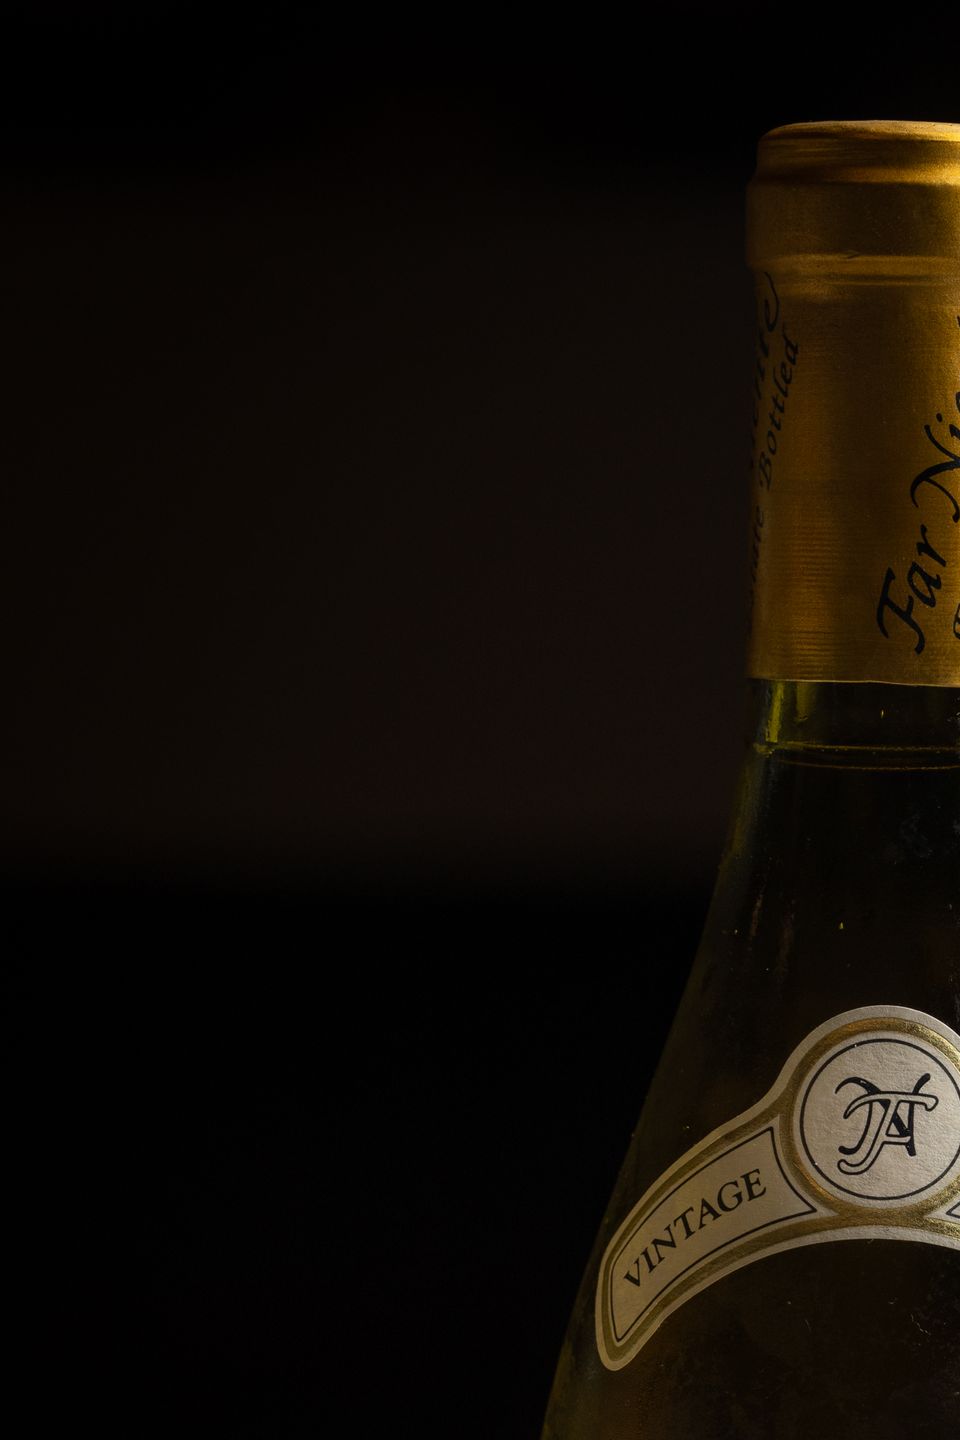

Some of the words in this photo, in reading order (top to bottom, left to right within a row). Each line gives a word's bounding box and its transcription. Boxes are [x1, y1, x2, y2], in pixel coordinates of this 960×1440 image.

[760, 321, 800, 491] Bottled
[875, 523, 947, 655] Far
[622, 1168, 768, 1289] VINTAGE
